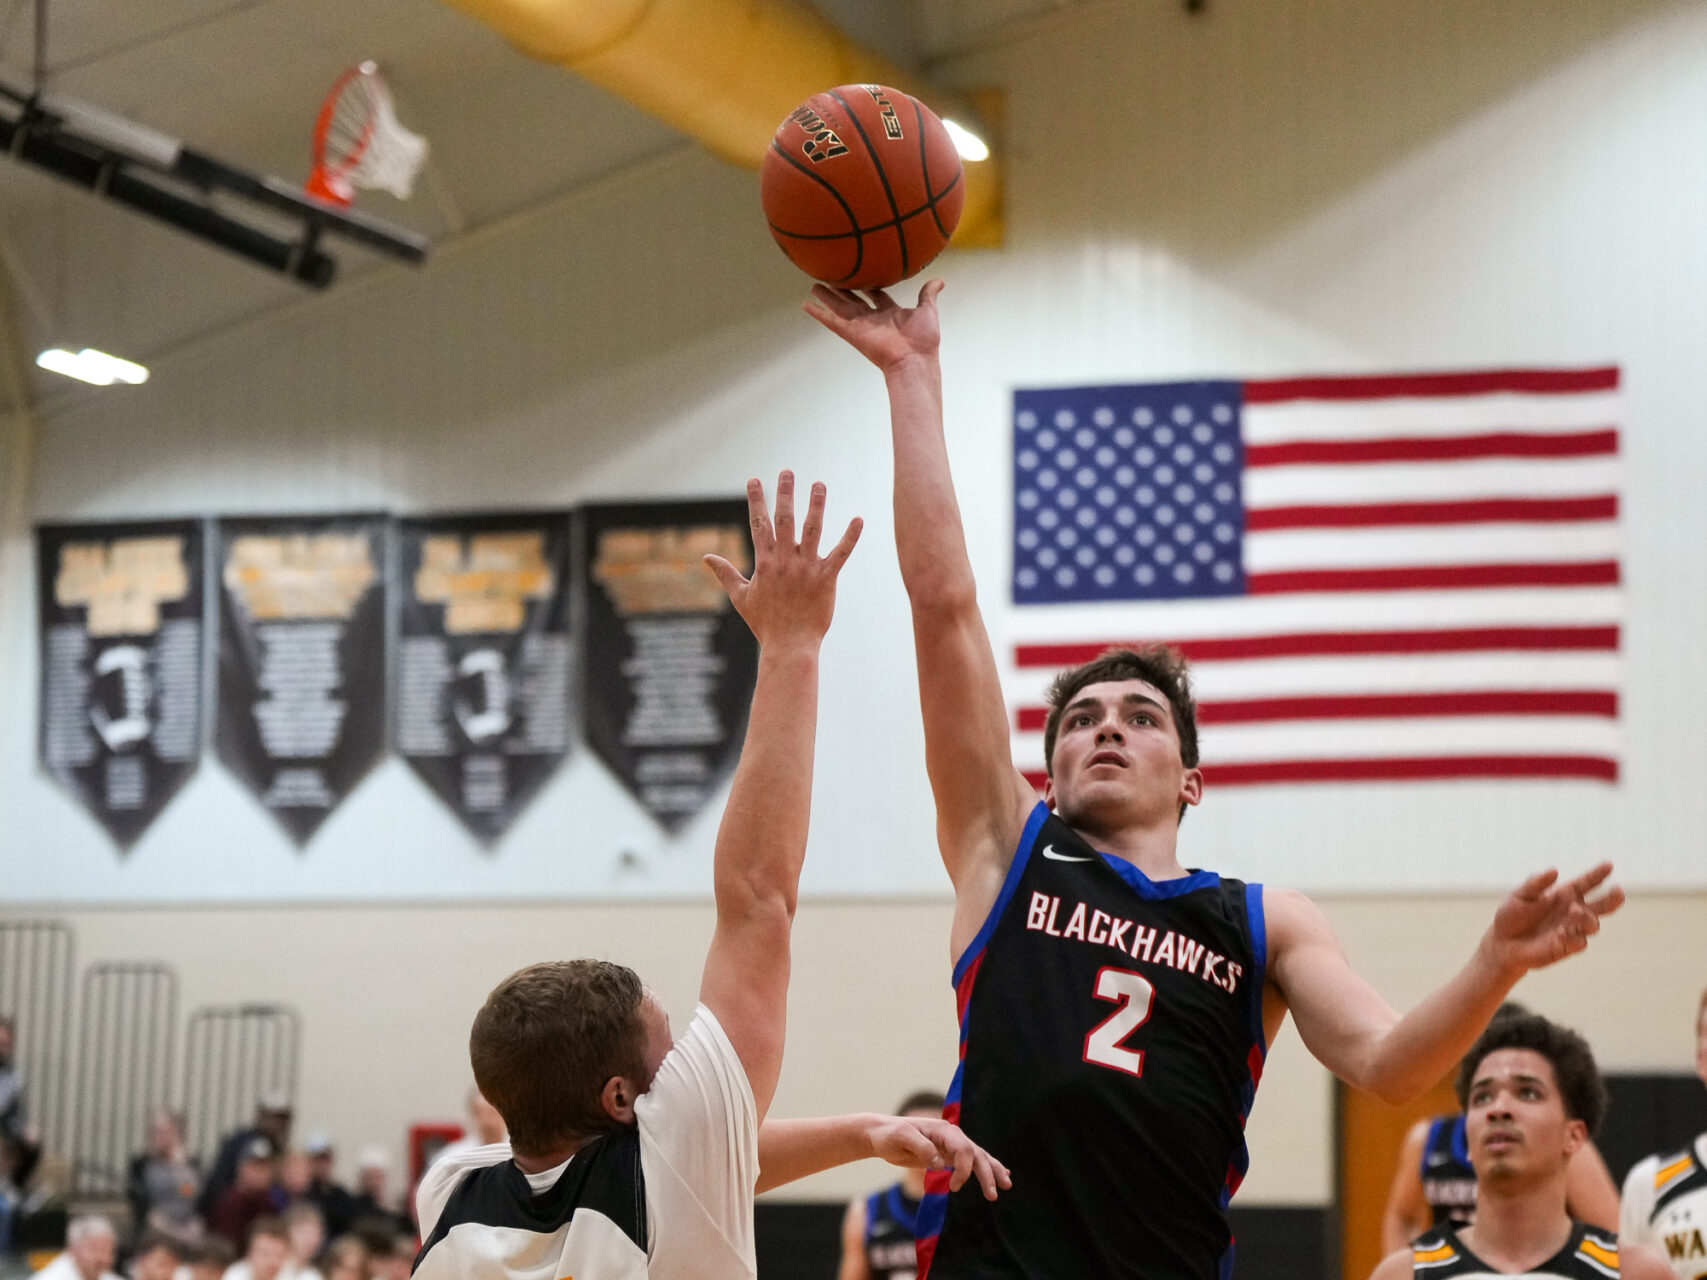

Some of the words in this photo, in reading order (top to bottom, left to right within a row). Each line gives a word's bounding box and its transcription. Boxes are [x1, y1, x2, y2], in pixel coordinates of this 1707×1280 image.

[778, 104, 851, 164] Bad
[1026, 891, 1243, 995] BLACKHAWKS
[1082, 965, 1156, 1078] 2
